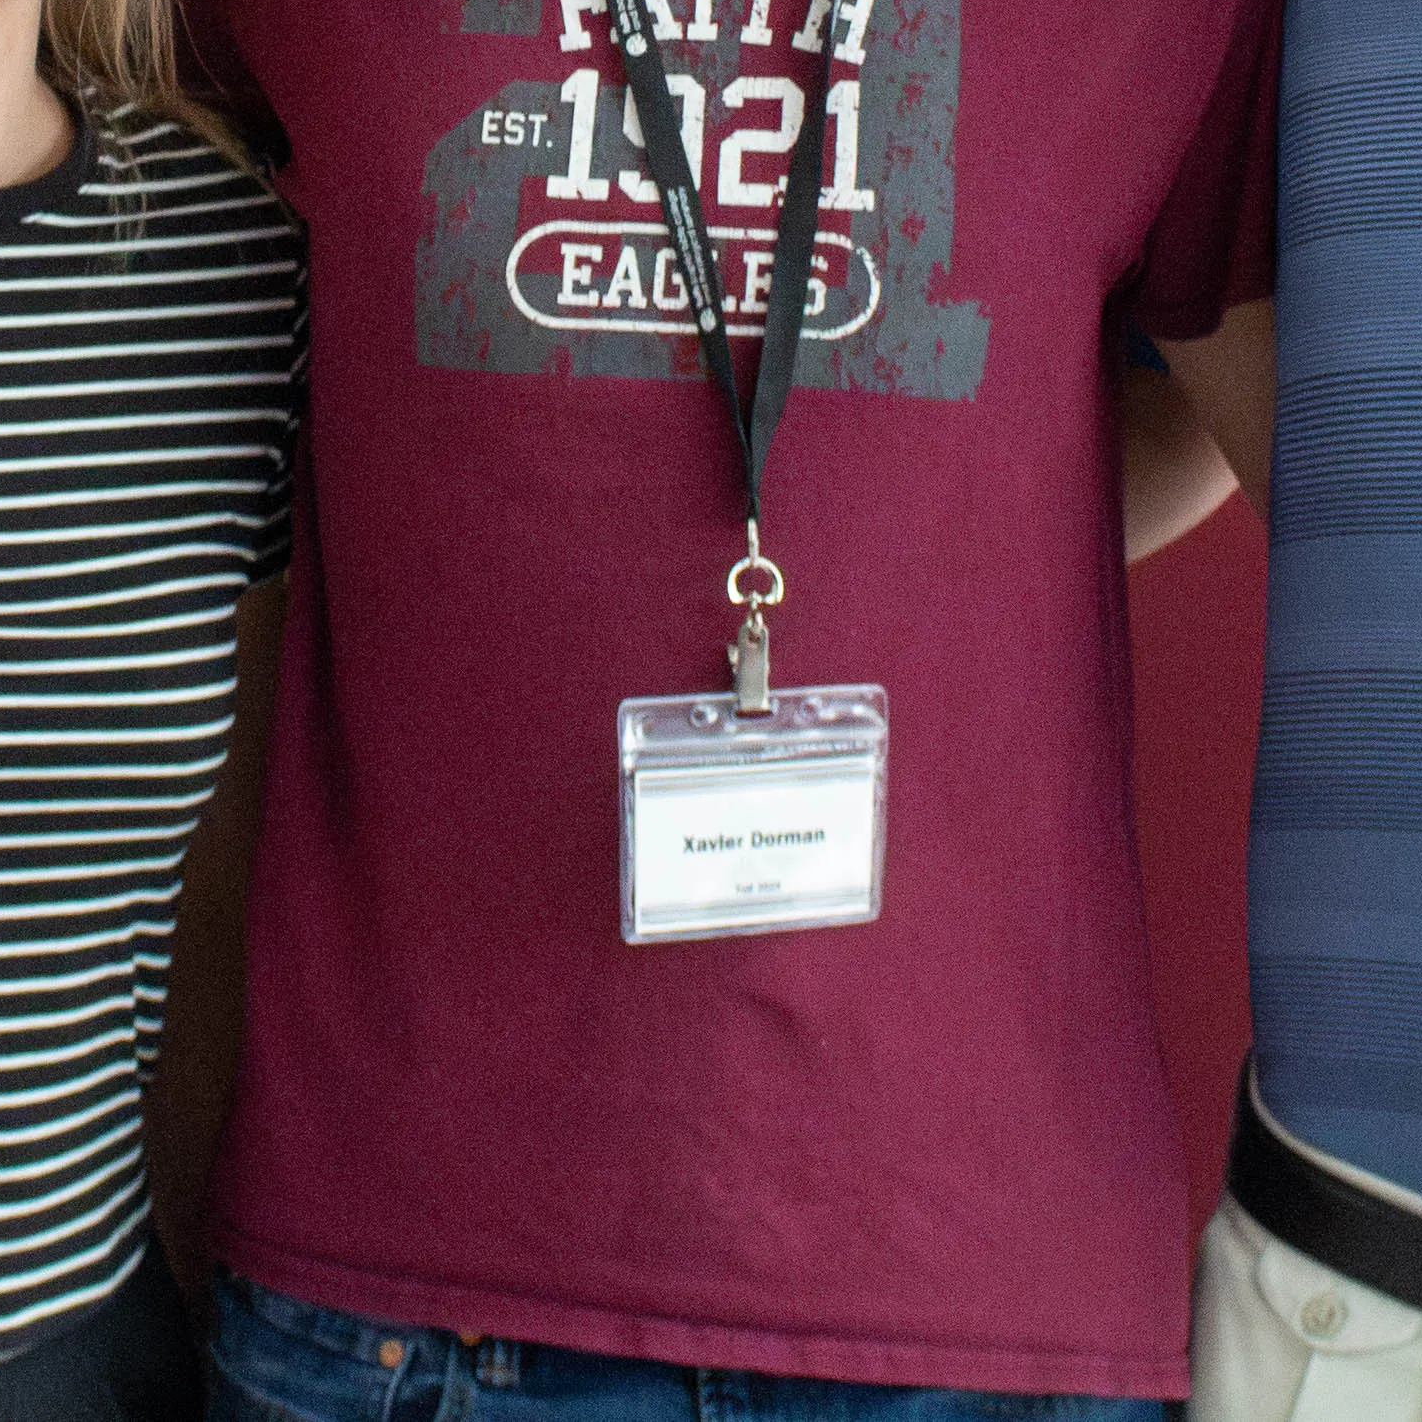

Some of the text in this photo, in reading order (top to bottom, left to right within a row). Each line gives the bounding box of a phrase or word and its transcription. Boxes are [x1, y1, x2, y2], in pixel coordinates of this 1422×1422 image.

[481, 68, 875, 211] EST. 1921
[683, 828, 826, 853] Xavier Dorman
